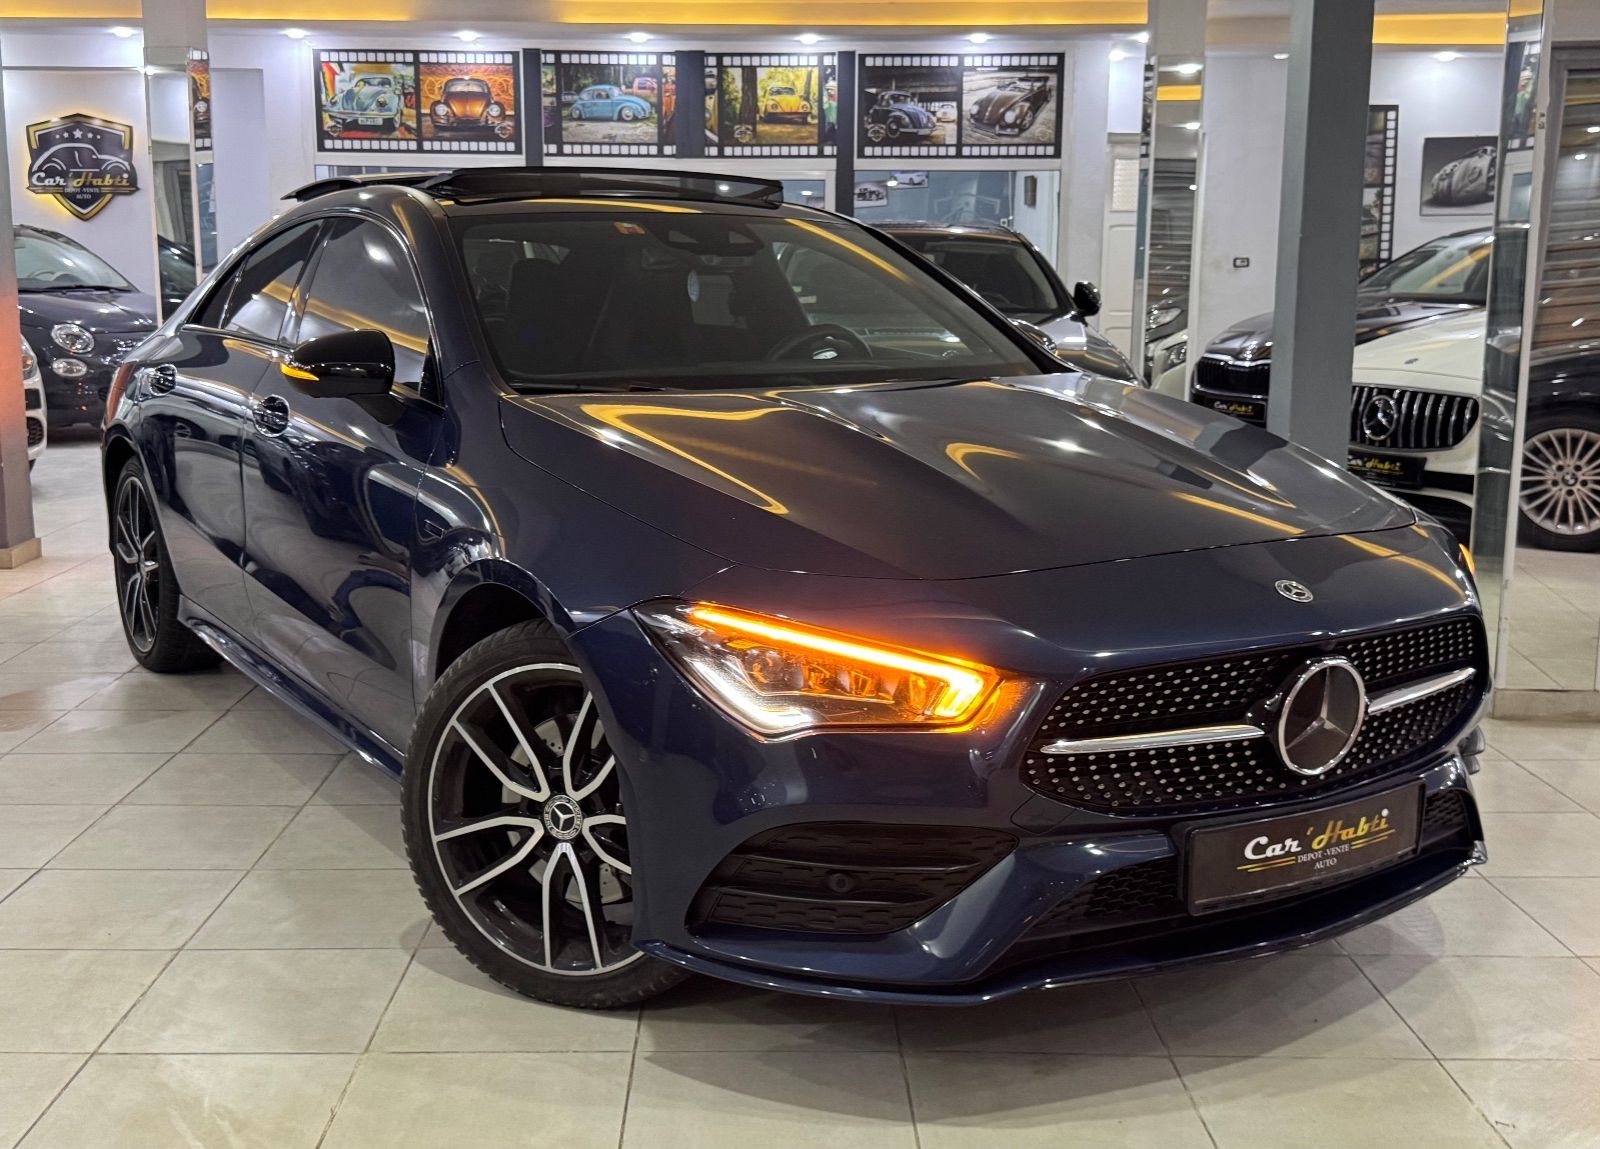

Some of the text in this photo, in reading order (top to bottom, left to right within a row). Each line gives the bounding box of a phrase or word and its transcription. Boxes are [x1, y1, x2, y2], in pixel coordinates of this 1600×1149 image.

[32, 172, 67, 186] Car
[1244, 835, 1302, 860] Car
[1314, 857, 1338, 870] AUTO
